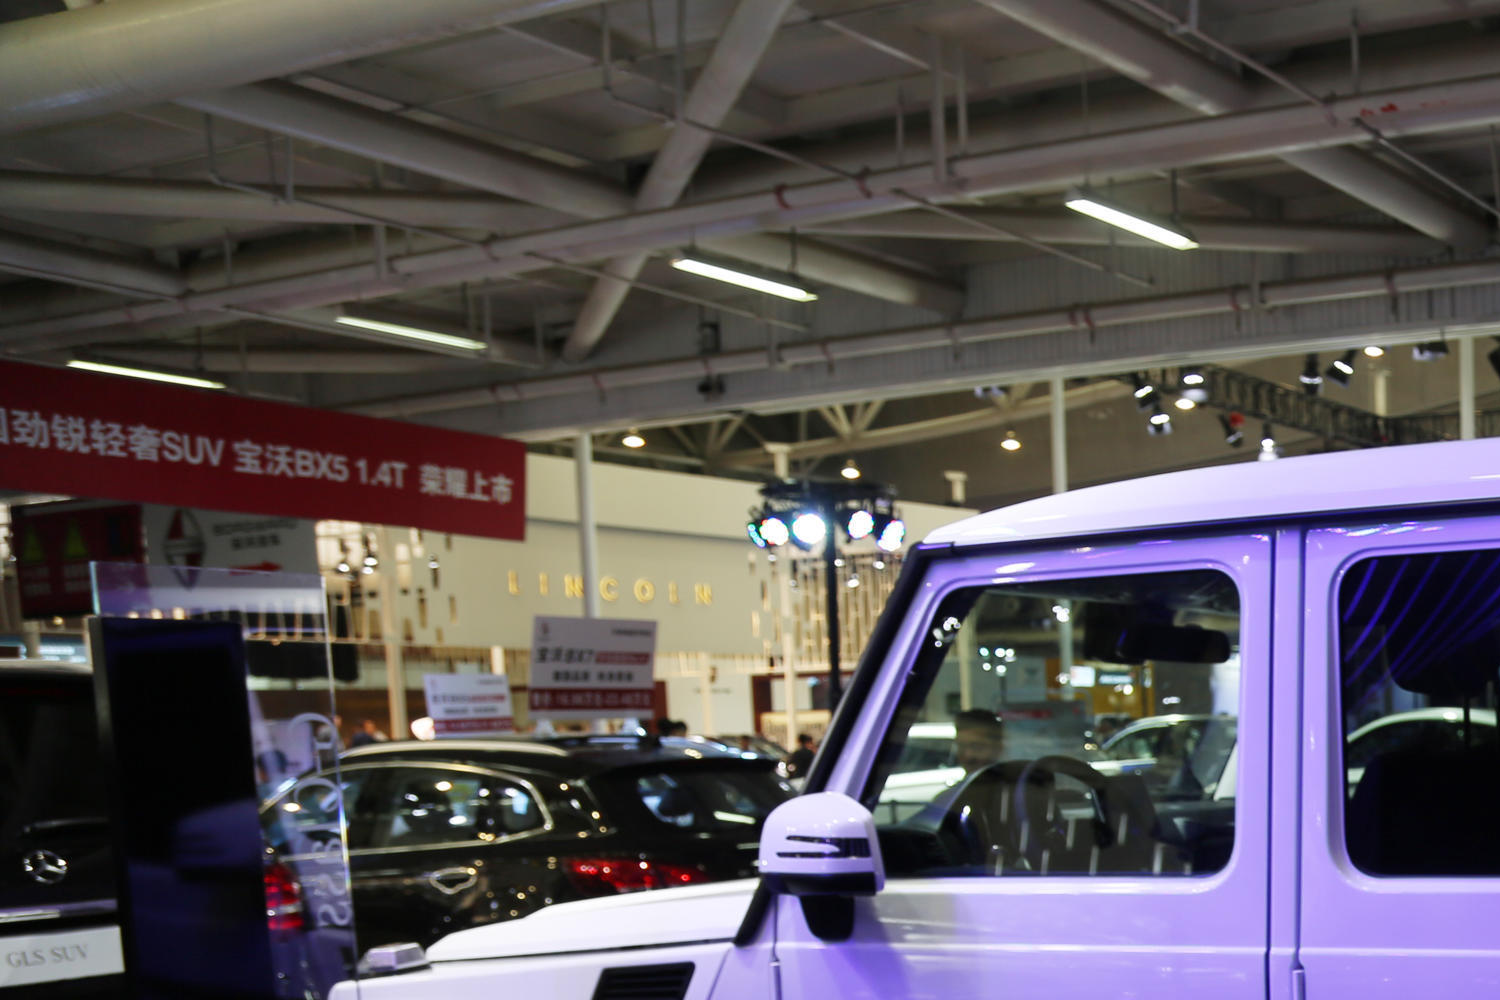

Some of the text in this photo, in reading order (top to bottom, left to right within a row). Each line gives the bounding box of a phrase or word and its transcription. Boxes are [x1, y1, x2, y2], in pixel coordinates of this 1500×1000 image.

[231, 440, 350, 482] 宝沃BX5
[354, 457, 408, 489] 1.4T
[418, 463, 514, 504] 荣耀上市
[507, 568, 713, 606] LINCOLN
[6, 943, 88, 968] GLS SUV
